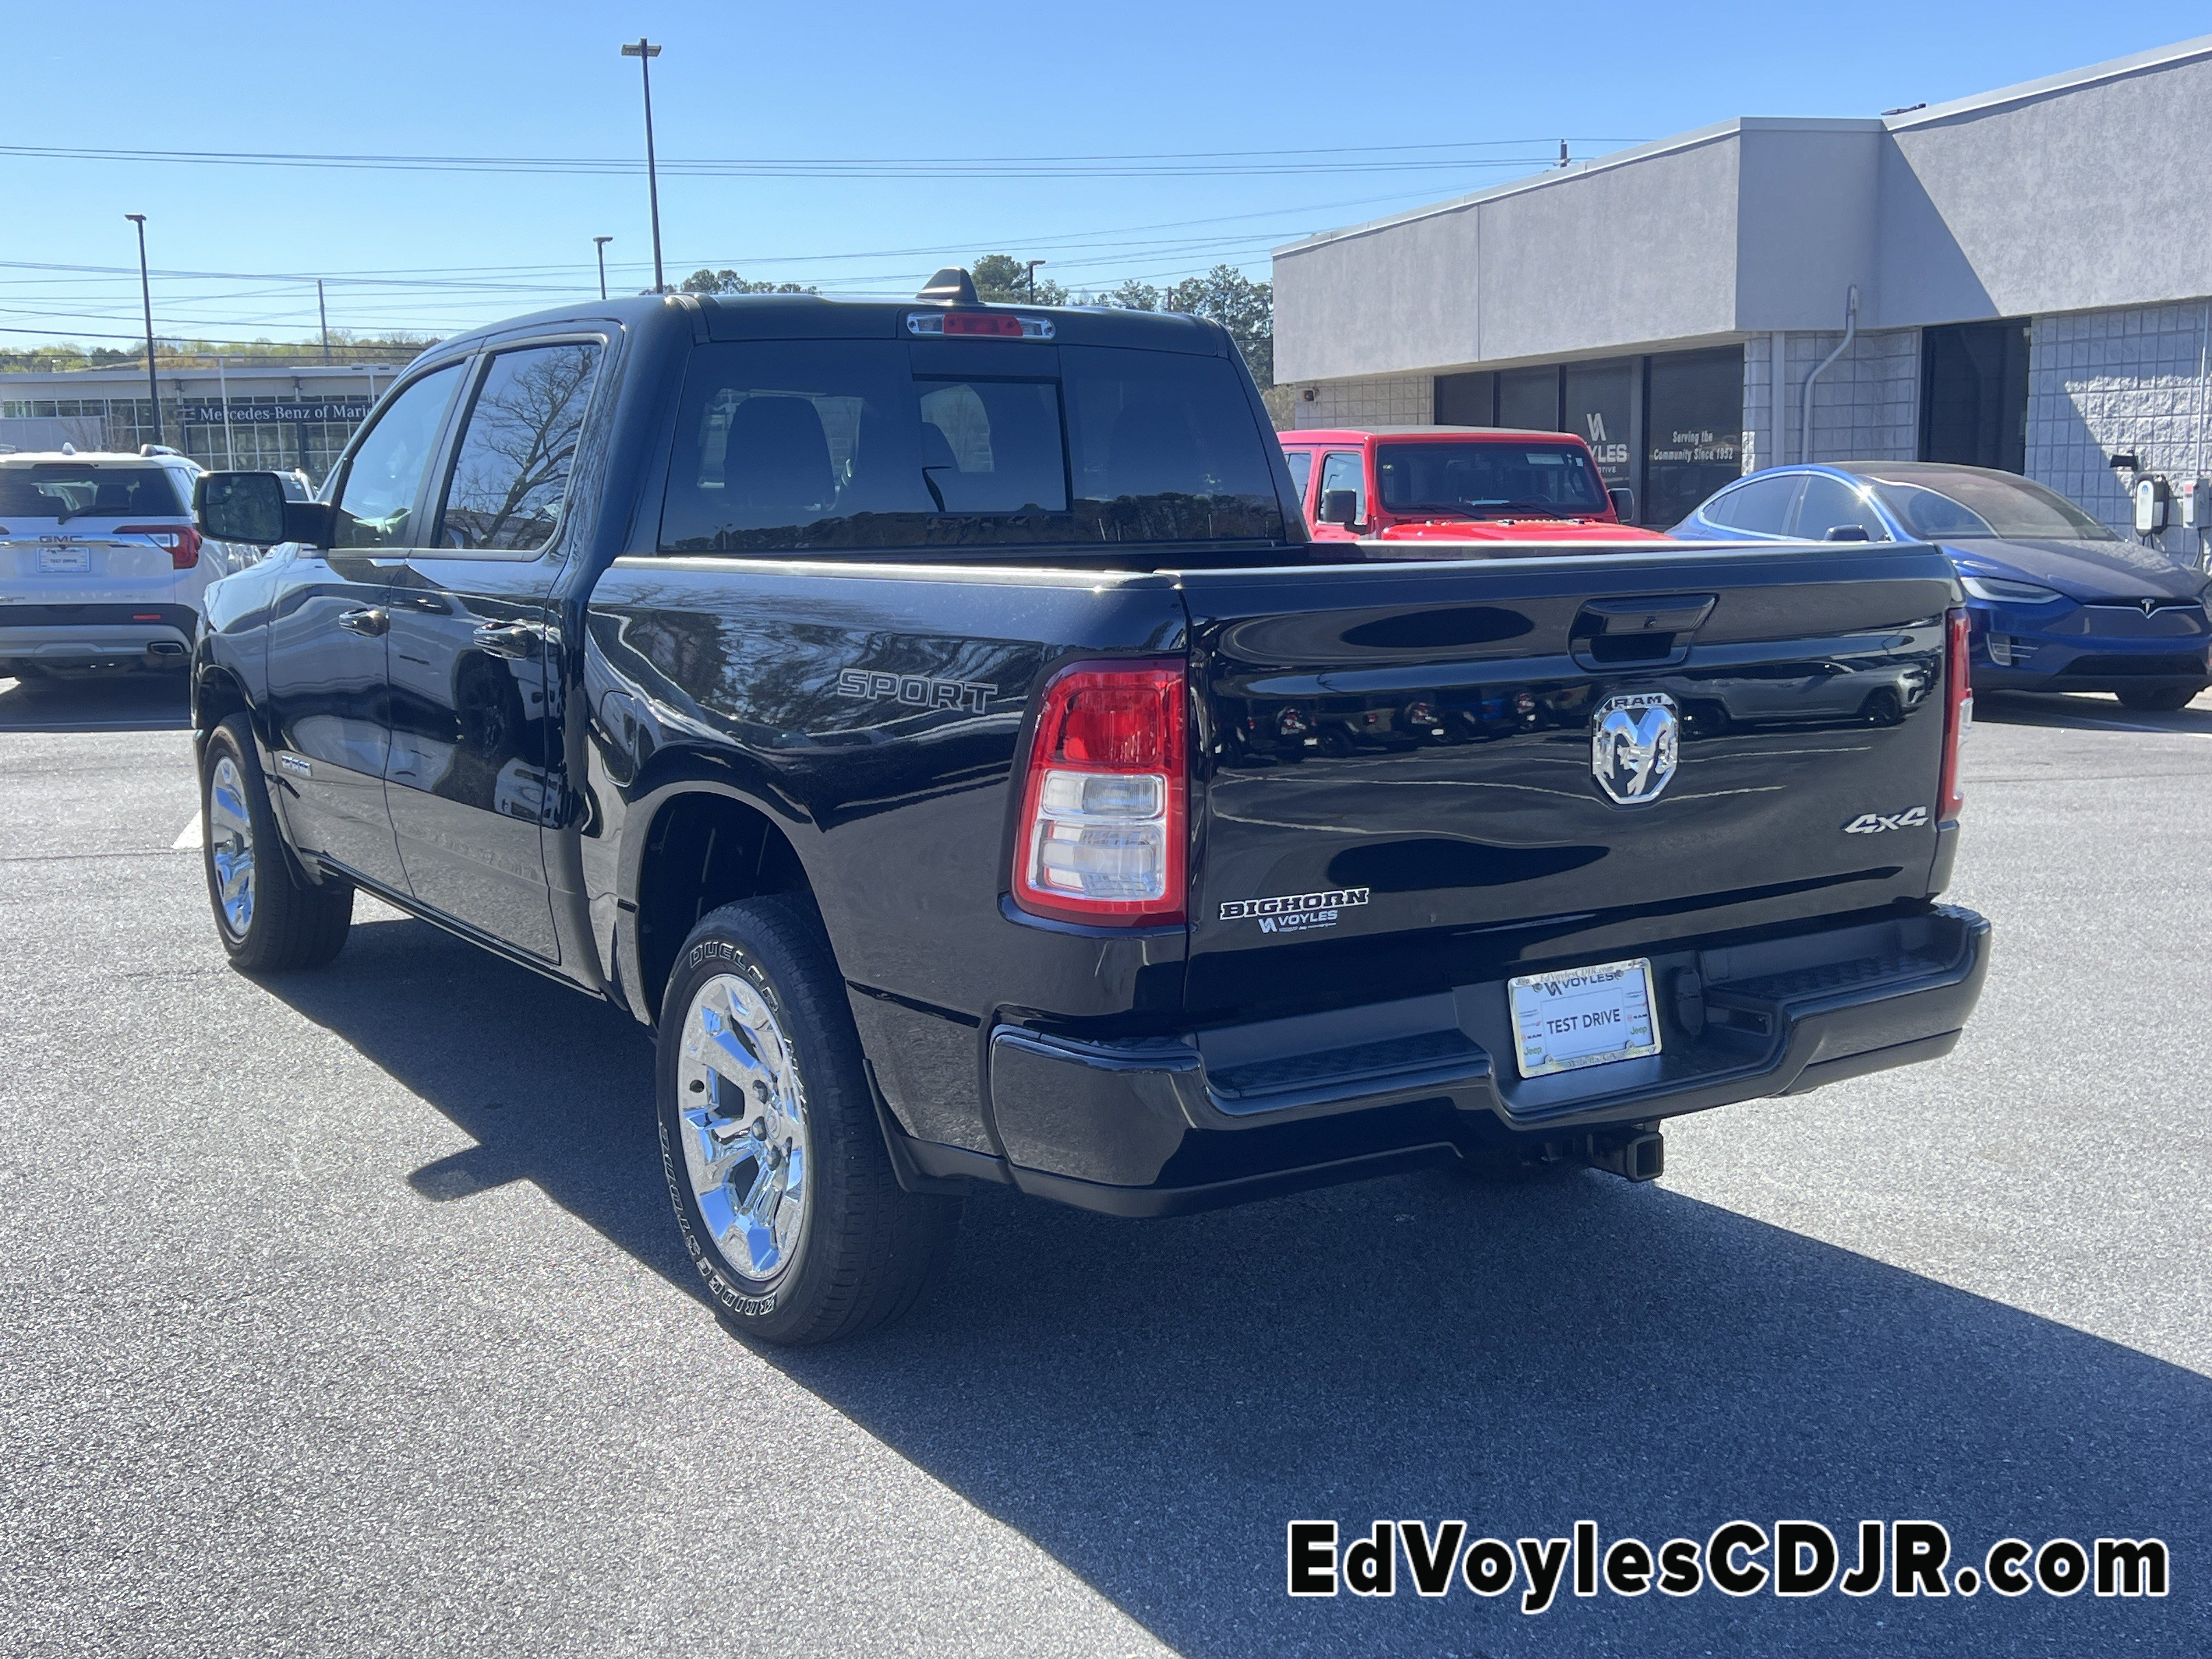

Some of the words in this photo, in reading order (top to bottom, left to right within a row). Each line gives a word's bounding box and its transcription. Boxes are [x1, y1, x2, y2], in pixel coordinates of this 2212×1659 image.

[200, 405, 310, 421] Mecedes-Benz
[314, 405, 328, 418] of
[1672, 431, 1700, 445] Serving
[1701, 430, 1713, 443] the
[1588, 443, 1627, 463] YLES
[1654, 448, 1691, 463] Community
[1694, 445, 1714, 460] Since
[1716, 447, 1733, 460] 1952
[39, 535, 83, 543] GMC
[837, 668, 998, 714] SPORT
[1615, 695, 1662, 707] RAM
[1278, 910, 1338, 926] VOYLES
[689, 941, 779, 1013] DUELER
[1562, 972, 1615, 989] VOYLES
[1547, 1016, 1578, 1035] TEST
[1583, 1008, 1621, 1028] DRIVE
